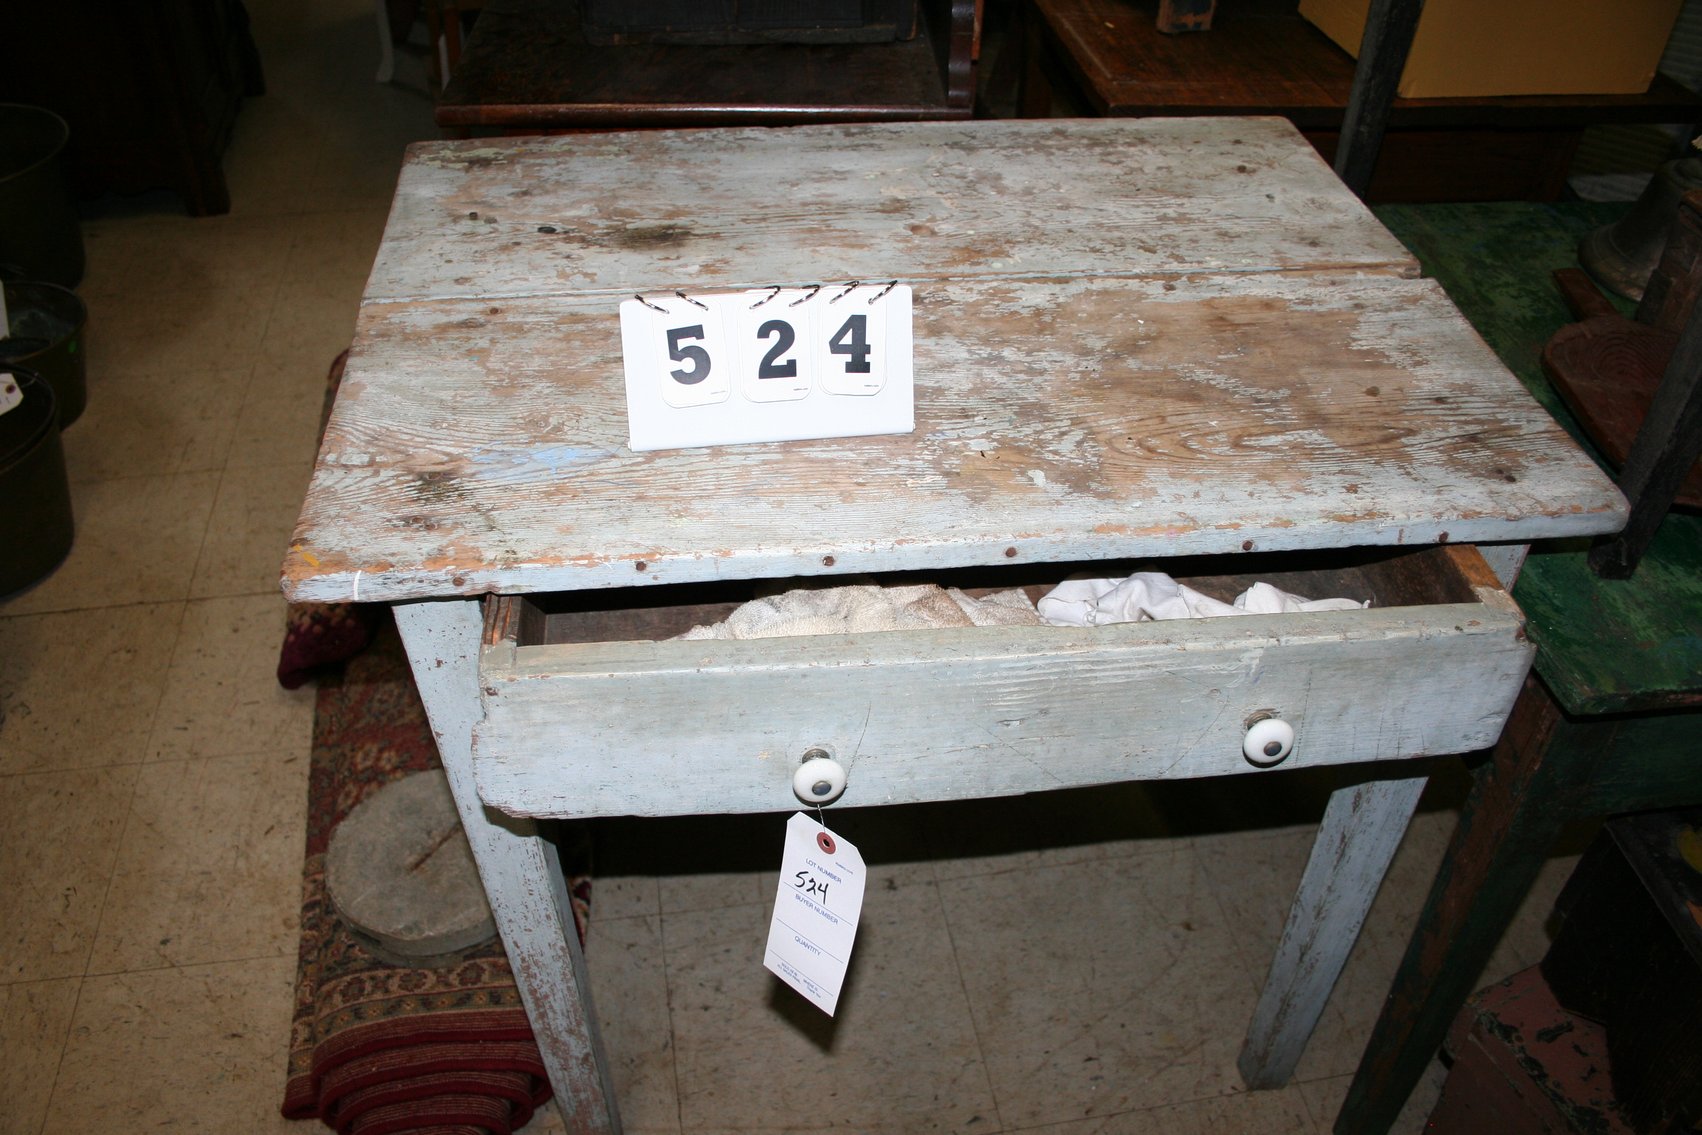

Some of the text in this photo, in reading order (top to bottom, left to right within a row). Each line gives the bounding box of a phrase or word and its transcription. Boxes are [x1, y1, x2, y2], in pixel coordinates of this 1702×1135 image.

[805, 857, 817, 870] LOT
[817, 864, 842, 884] NUMBER
[794, 870, 829, 905] 524
[795, 893, 839, 925] BUYER NUMBER
[794, 935, 822, 956] QUANTITY
